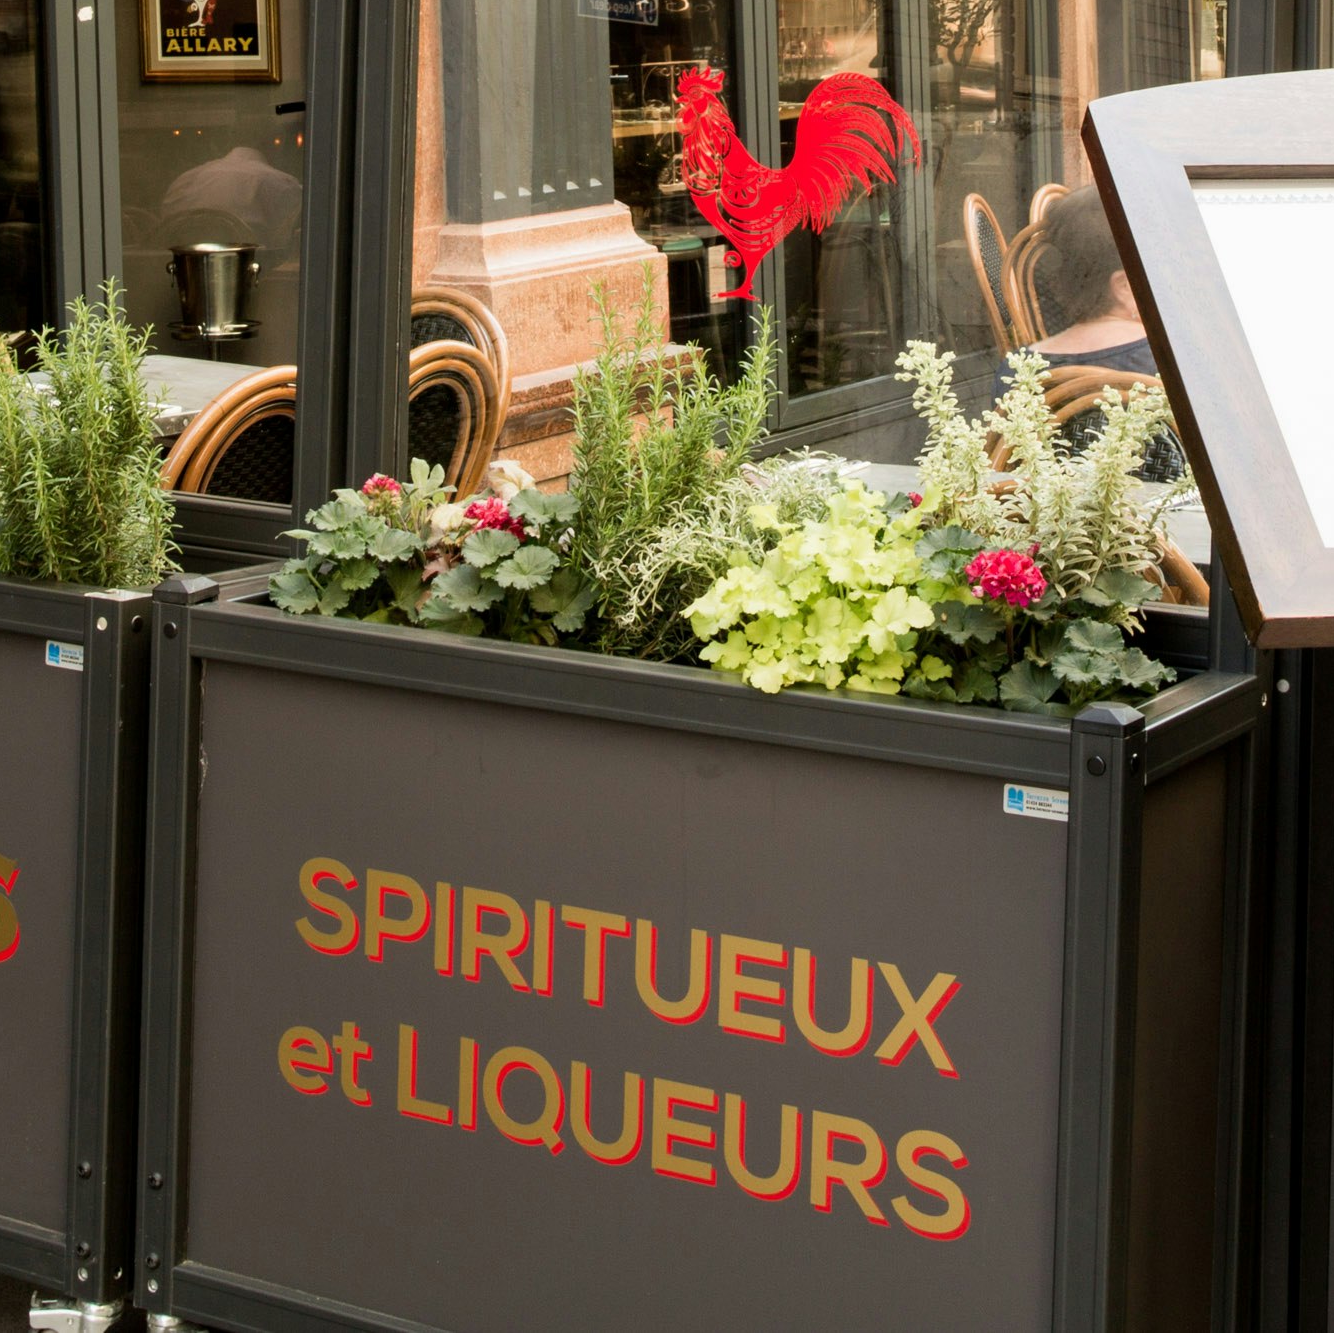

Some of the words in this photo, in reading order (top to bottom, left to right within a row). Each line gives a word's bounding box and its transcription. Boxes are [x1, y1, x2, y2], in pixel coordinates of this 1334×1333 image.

[166, 25, 206, 37] BIÈRE
[166, 37, 253, 52] ALLARY
[295, 856, 963, 1080] SPIRITUEUX
[277, 1020, 373, 1107] et
[396, 1022, 972, 1242] LIQUEURS
